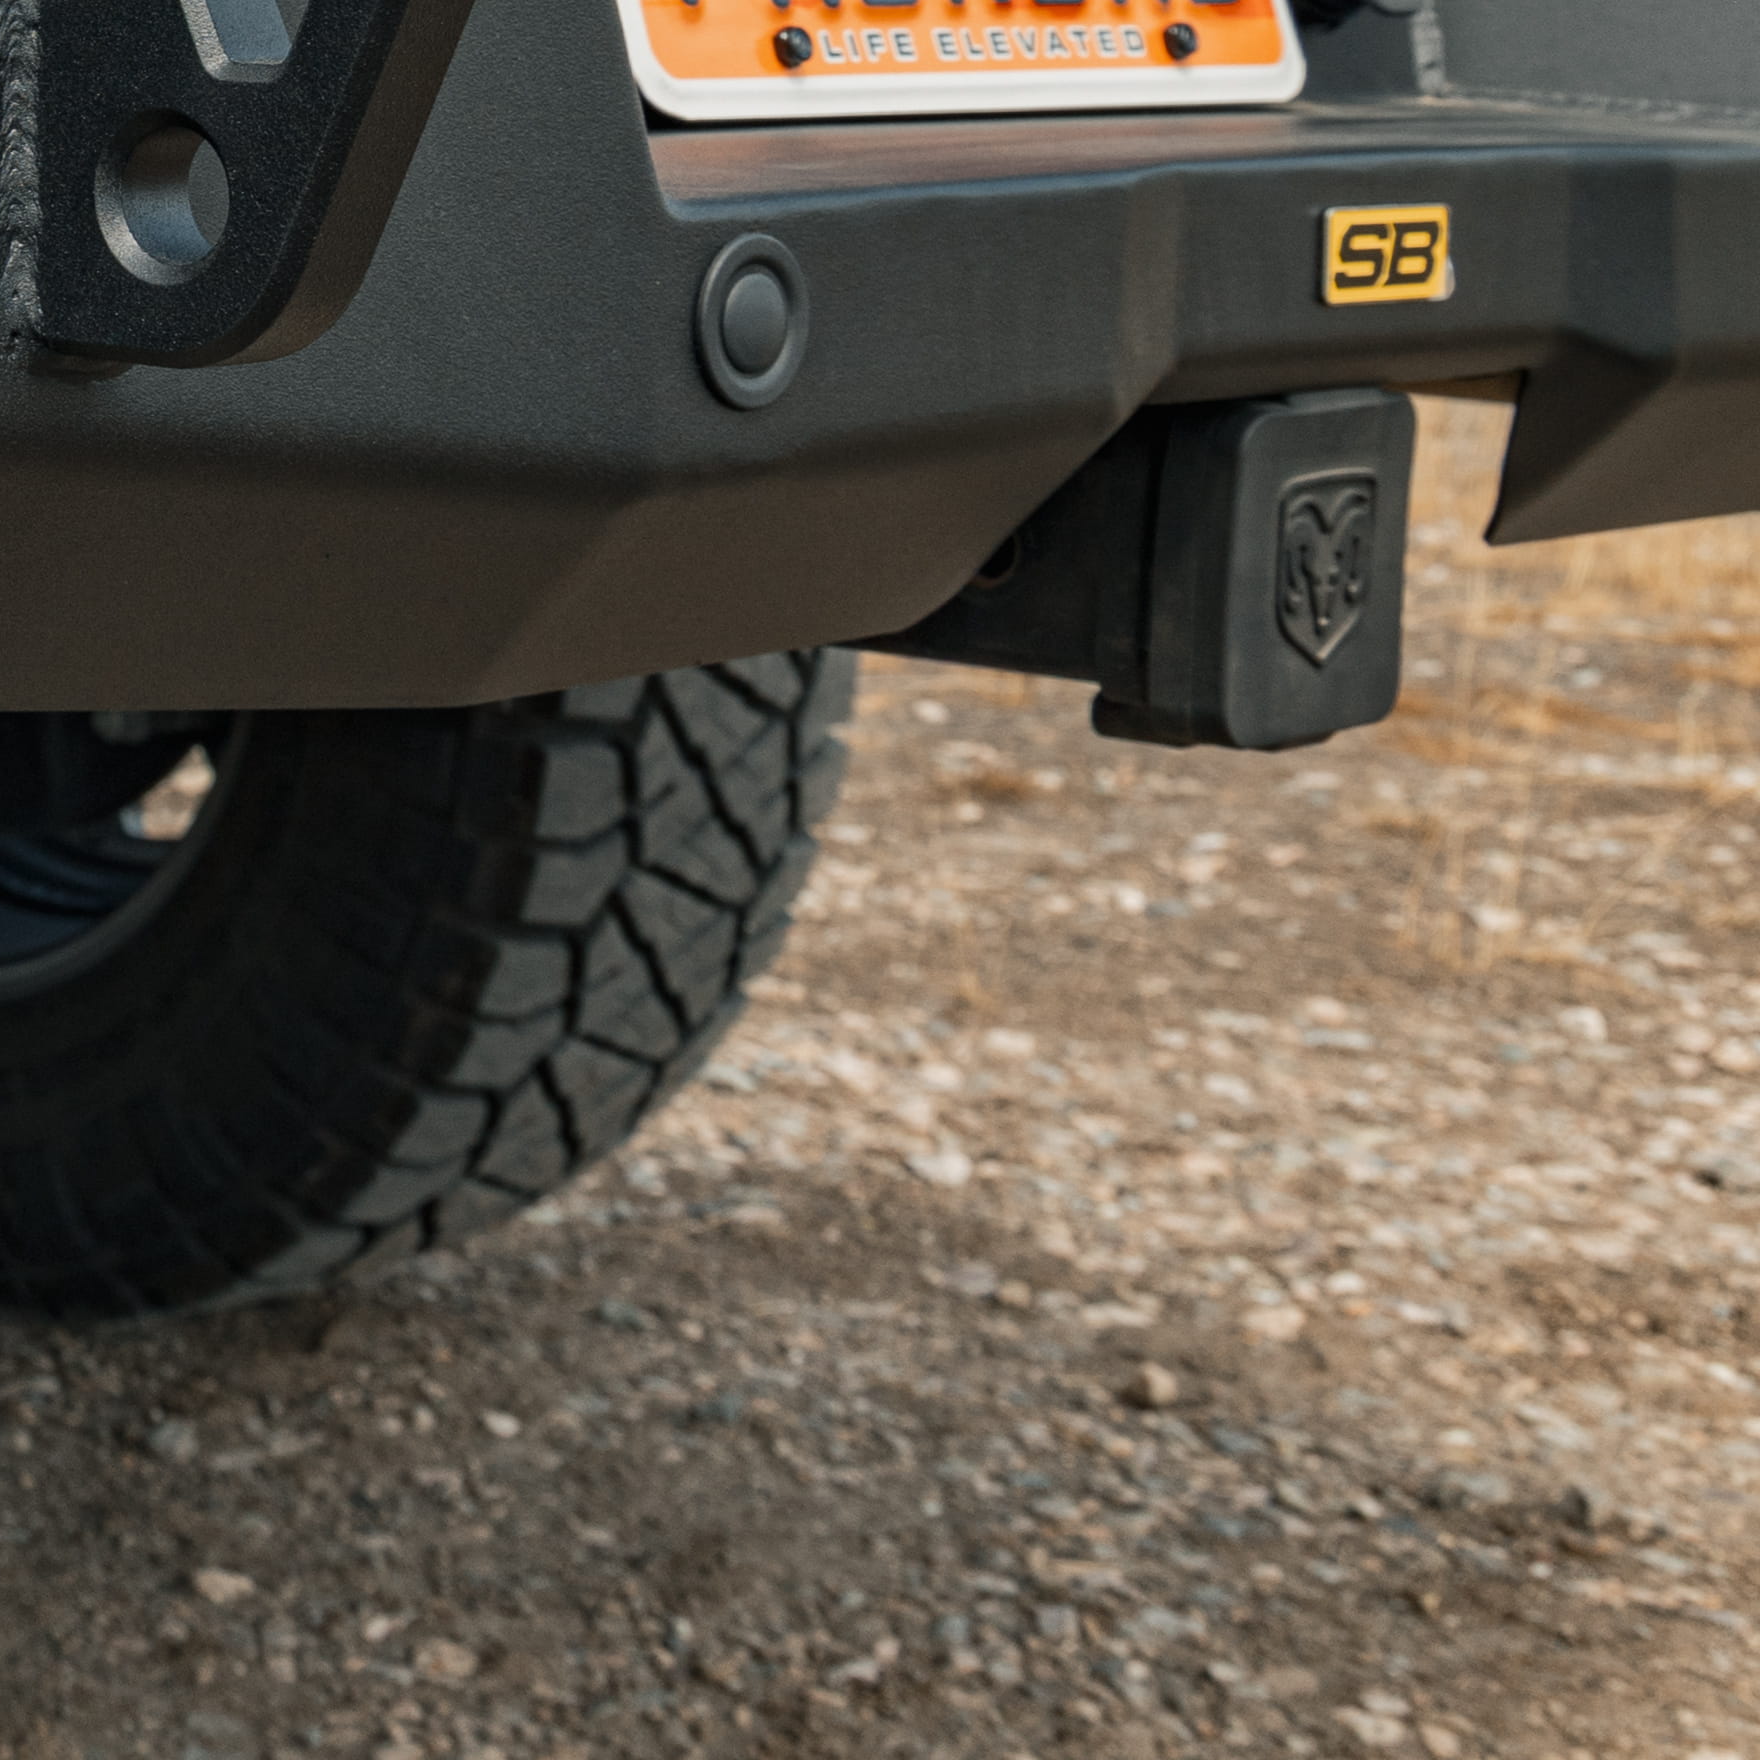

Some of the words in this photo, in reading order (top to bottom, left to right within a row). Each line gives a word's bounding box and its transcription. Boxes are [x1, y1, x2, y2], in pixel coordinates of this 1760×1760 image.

[820, 27, 918, 62] LIFE
[937, 27, 1147, 60] ELEVATED
[1334, 220, 1440, 289] SB
